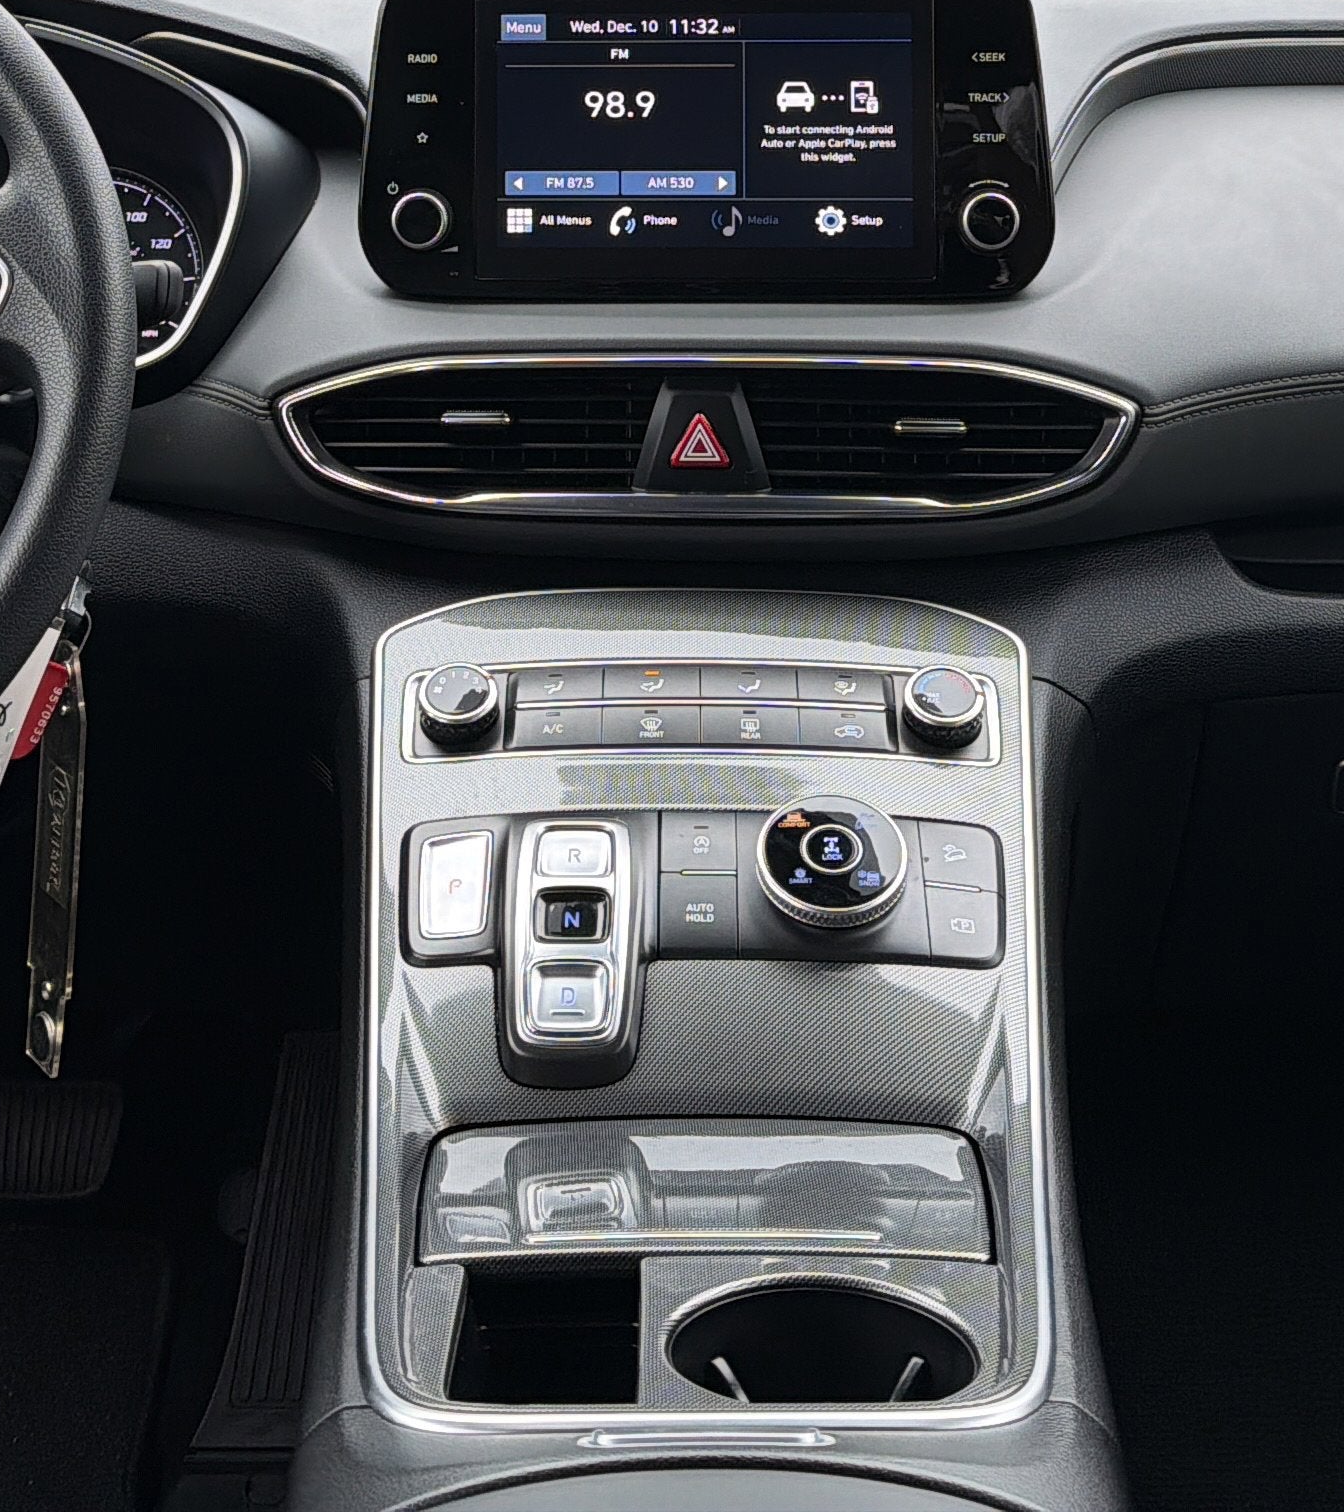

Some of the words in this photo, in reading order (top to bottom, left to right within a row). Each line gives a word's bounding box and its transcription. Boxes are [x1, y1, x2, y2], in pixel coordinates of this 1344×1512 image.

[505, 21, 542, 33] Menu
[607, 20, 637, 33] Dec.
[641, 20, 659, 33] 10
[669, 18, 719, 35] 11:32
[721, 25, 736, 34] AM
[407, 53, 438, 64] RADIO
[610, 48, 629, 60] FM
[978, 52, 1006, 62] SEEK
[406, 93, 438, 104] MEDIA
[967, 92, 1002, 103] TRACK
[584, 90, 656, 118] 98.9
[764, 125, 775, 134] To
[776, 125, 801, 134] start
[802, 125, 854, 136] connecting
[856, 125, 893, 134] Android
[972, 133, 1006, 143] SETUP
[760, 139, 784, 148] Auto
[785, 140, 796, 148] or
[798, 139, 826, 149] Apple
[869, 140, 897, 149] press
[801, 152, 819, 162] this
[820, 152, 857, 163] widget.
[545, 177, 564, 189] FM
[567, 177, 595, 189] 87.5
[647, 177, 667, 189] AM
[669, 177, 694, 189] 530
[126, 211, 148, 222] 100
[539, 215, 554, 225] All
[556, 215, 593, 225] Menus
[643, 215, 678, 225] Phone
[747, 215, 779, 225] Media
[851, 214, 884, 227] Setup
[150, 238, 173, 249] 120
[29, 686, 63, 745] 9570633
[543, 724, 564, 735] A/C
[639, 731, 665, 739] FRONT
[740, 731, 761, 739] REAR
[567, 848, 582, 863] R
[693, 846, 709, 854] OFF
[822, 853, 844, 861] LOCK
[448, 878, 463, 895] P
[788, 877, 813, 885] SMART
[685, 903, 714, 912] AUTO
[563, 911, 581, 928] N
[685, 913, 715, 923] HOLD
[560, 987, 576, 1007] D
